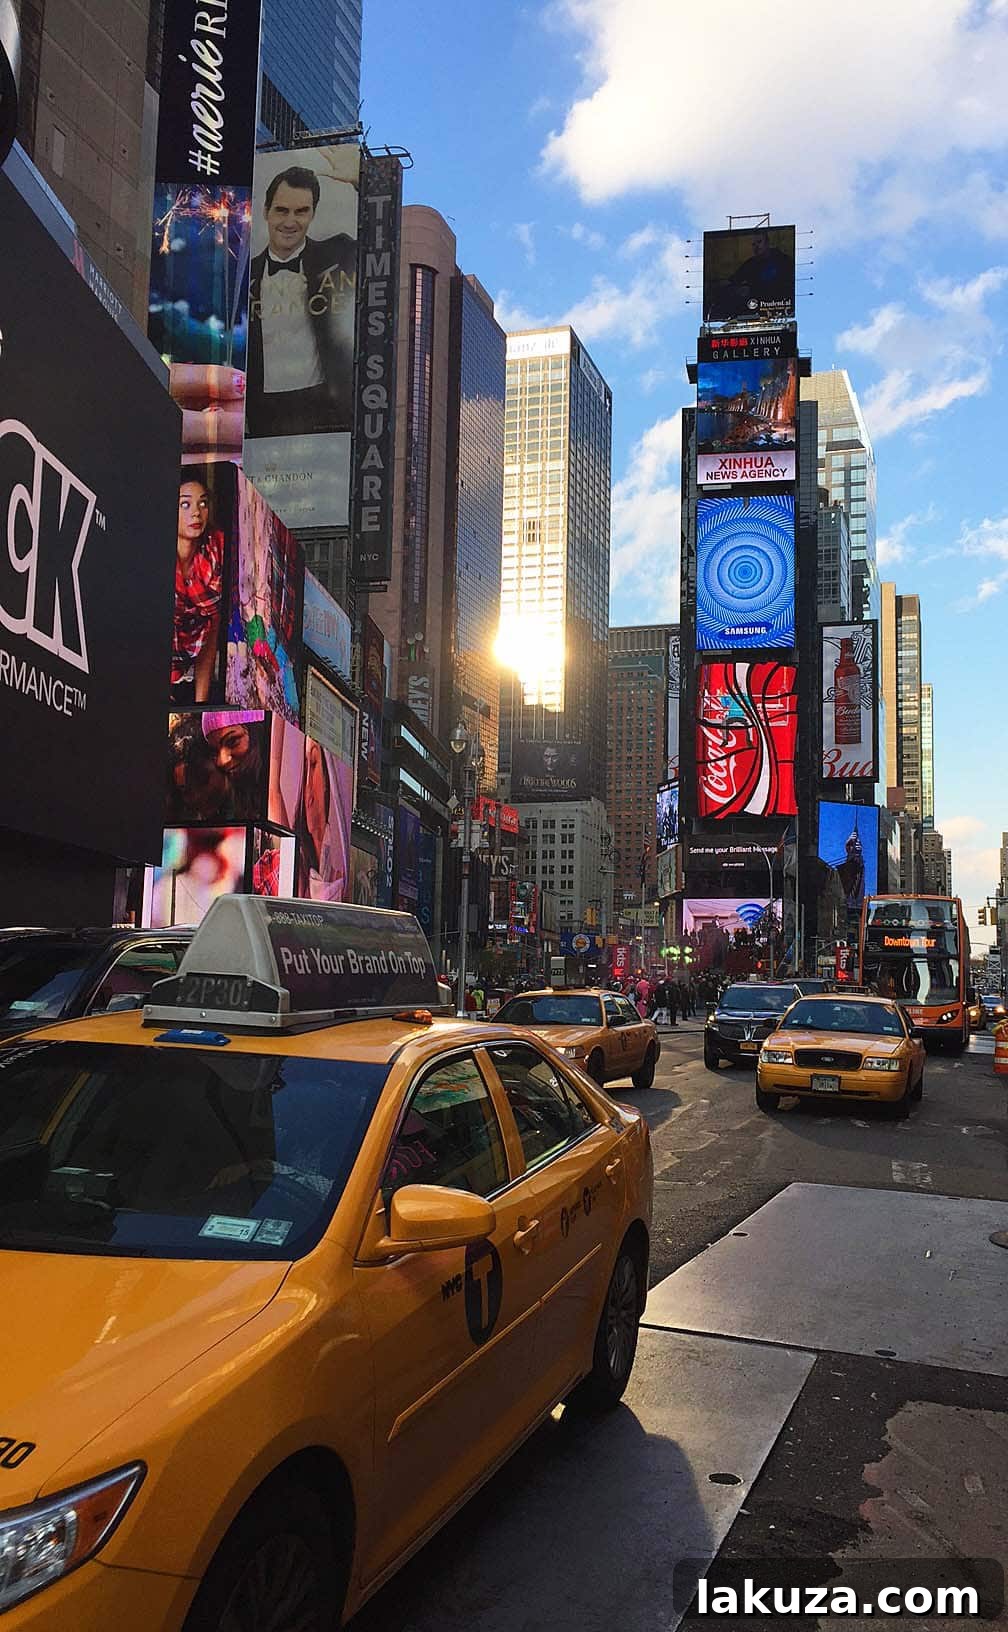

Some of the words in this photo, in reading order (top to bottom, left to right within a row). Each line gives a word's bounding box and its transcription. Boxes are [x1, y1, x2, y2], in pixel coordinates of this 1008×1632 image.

[194, 0, 227, 38] R
[178, 39, 226, 175] #aerie
[366, 194, 392, 336] TIMES
[750, 335, 781, 347] XINHUA
[712, 346, 780, 360] GALLERY
[361, 354, 389, 532] SQUARE
[718, 456, 775, 471] XINHUA
[264, 471, 313, 482] CHANDON
[706, 470, 738, 481] NEWS
[740, 467, 788, 479] AGENCY
[360, 552, 379, 562] NYC
[725, 626, 767, 635] SAMSUNG
[715, 847, 728, 855] your
[884, 935, 919, 948] Downtown
[920, 936, 936, 947] Tour
[280, 946, 311, 975] Put
[312, 948, 345, 975] Your
[349, 949, 387, 974] Brand
[390, 950, 404, 973] On
[406, 951, 427, 980] Top
